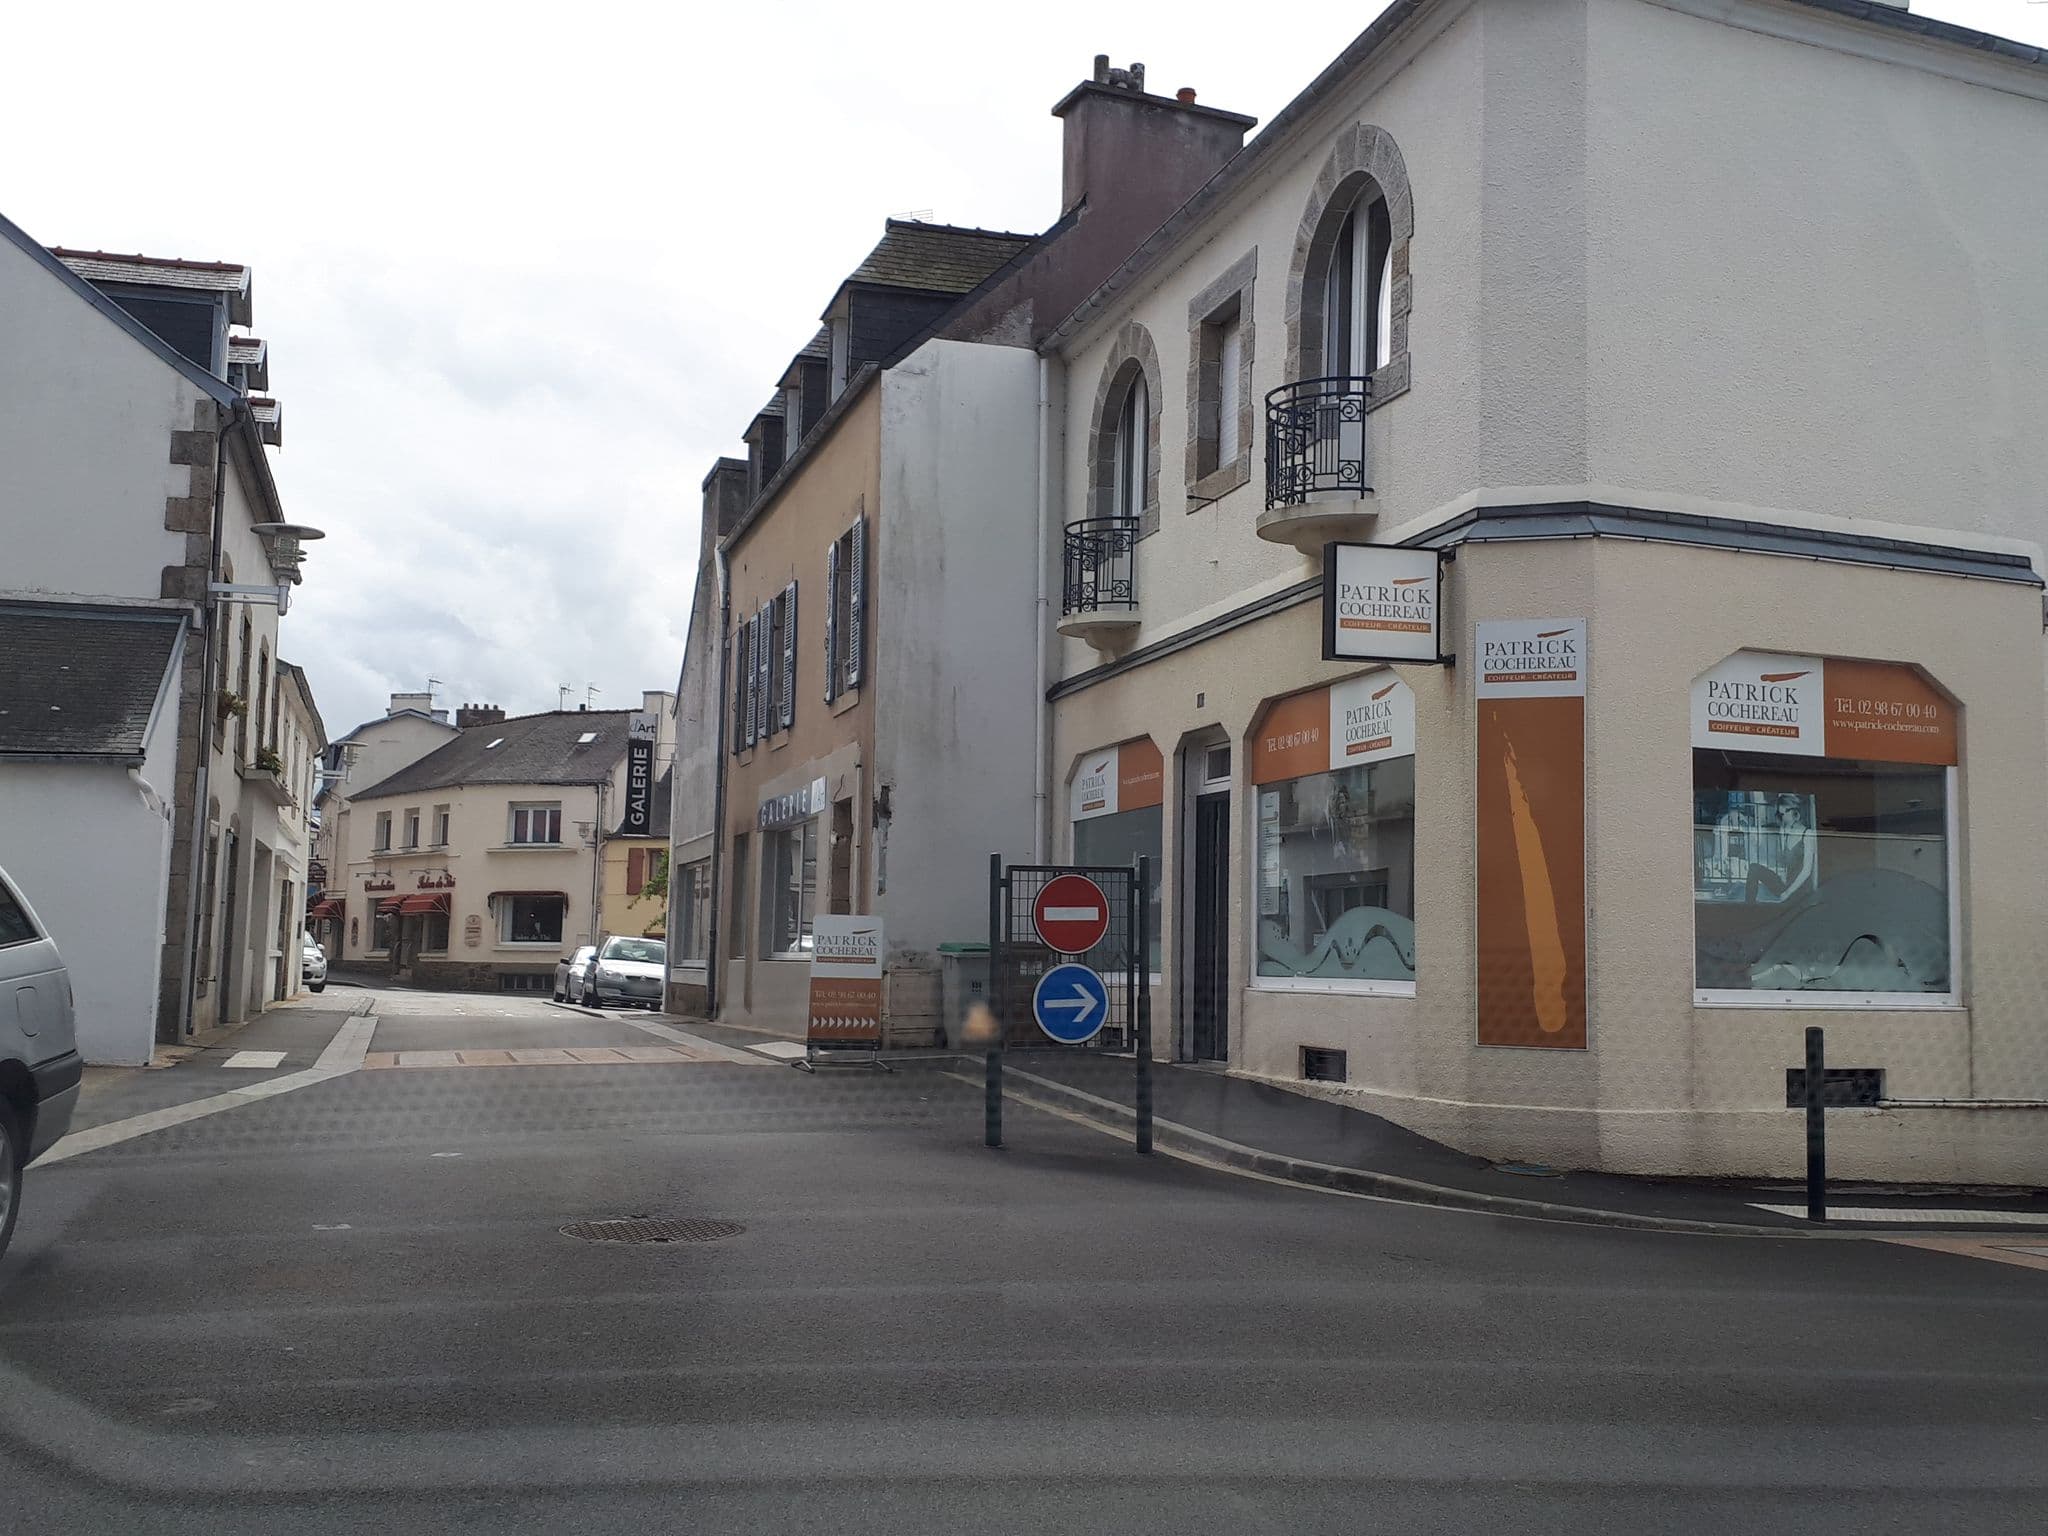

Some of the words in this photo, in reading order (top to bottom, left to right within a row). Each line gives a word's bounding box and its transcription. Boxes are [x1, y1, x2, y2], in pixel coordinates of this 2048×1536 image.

[1340, 584, 1432, 604] PATRICK
[1340, 602, 1431, 619] COCHEREAU
[1484, 640, 1576, 656] PATRICK
[1484, 656, 1576, 671] COCHEREAU
[1708, 681, 1799, 705] PATRICK
[1346, 700, 1392, 726] PATRICK
[1708, 701, 1799, 722] COCHEREAU
[1834, 698, 1856, 714] Tél.
[1858, 700, 1872, 714] 02
[1874, 701, 1888, 716] 98
[1890, 702, 1904, 716] 67
[1906, 704, 1921, 718] 00
[1922, 705, 1937, 719] 40
[1311, 727, 1319, 742] 40
[1345, 719, 1392, 742] COCHEREAU
[1711, 723, 1750, 732] COIFFEUR
[1756, 726, 1797, 736] CRÉATEUR
[1832, 718, 1939, 734] www.patrick-cochereau.com
[630, 747, 648, 825] GALERIE
[761, 789, 807, 827] GALERIE
[817, 935, 877, 946] PATRICK
[816, 945, 877, 956] COCHEREAU
